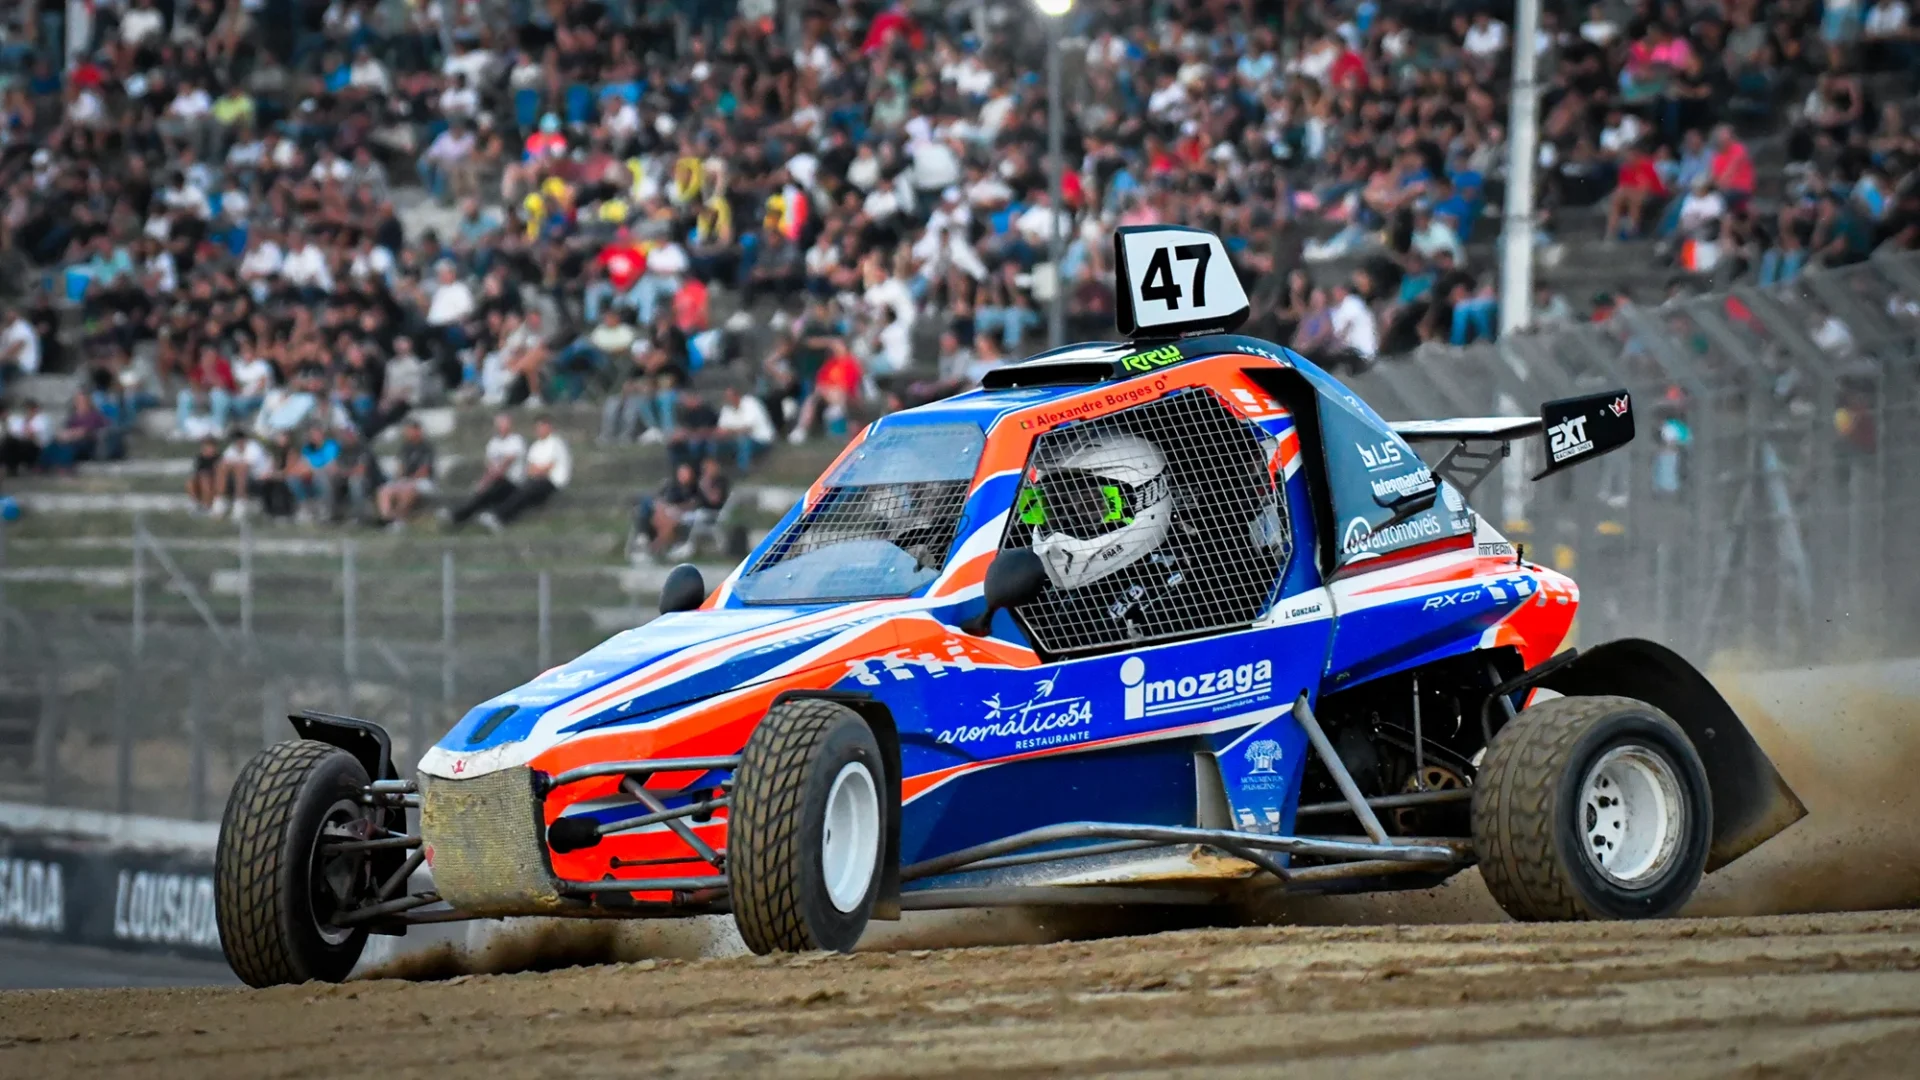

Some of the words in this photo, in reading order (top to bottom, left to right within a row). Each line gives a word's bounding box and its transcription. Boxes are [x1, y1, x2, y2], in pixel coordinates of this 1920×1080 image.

[1141, 242, 1212, 310] 47
[1121, 344, 1183, 371] RRW
[1036, 401, 1103, 427] Alexandre
[1105, 383, 1152, 406] Borges
[1547, 415, 1587, 453] EXT
[1555, 448, 1576, 460] RACING
[1422, 592, 1460, 611] RX
[1015, 731, 1090, 749] RESTAURANTE
